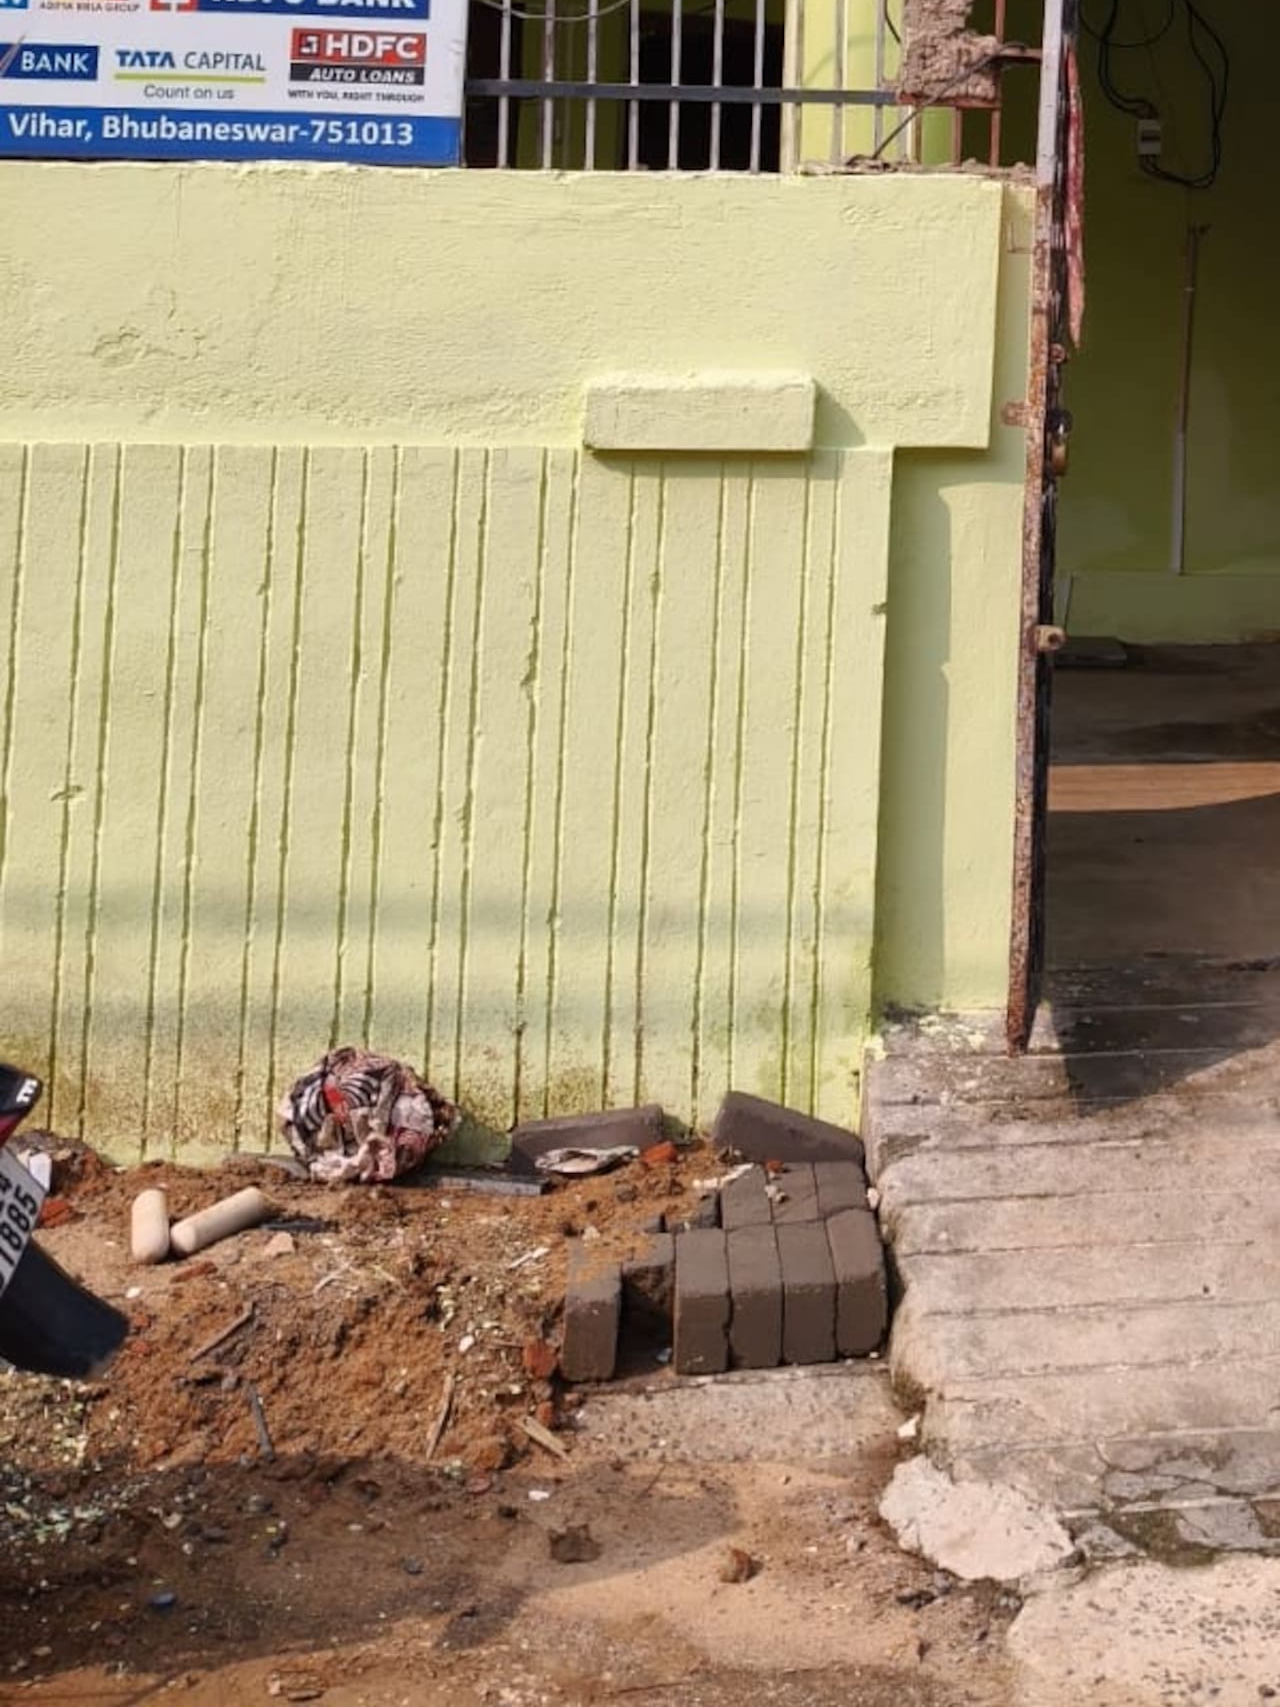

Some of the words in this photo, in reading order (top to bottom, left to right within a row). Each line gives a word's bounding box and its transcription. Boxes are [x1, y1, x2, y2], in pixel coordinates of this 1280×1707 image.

[325, 33, 420, 59] HDFC
[21, 50, 90, 74] BANK
[115, 50, 176, 69] TATA
[184, 51, 267, 72] CAPITAL
[308, 67, 356, 82] AUTO
[359, 69, 416, 84] LOANS
[143, 83, 190, 100] Count
[194, 86, 213, 101] on
[217, 89, 236, 101] us
[8, 112, 93, 142] Vihar,
[102, 115, 414, 146] Bhubaneswar-751013
